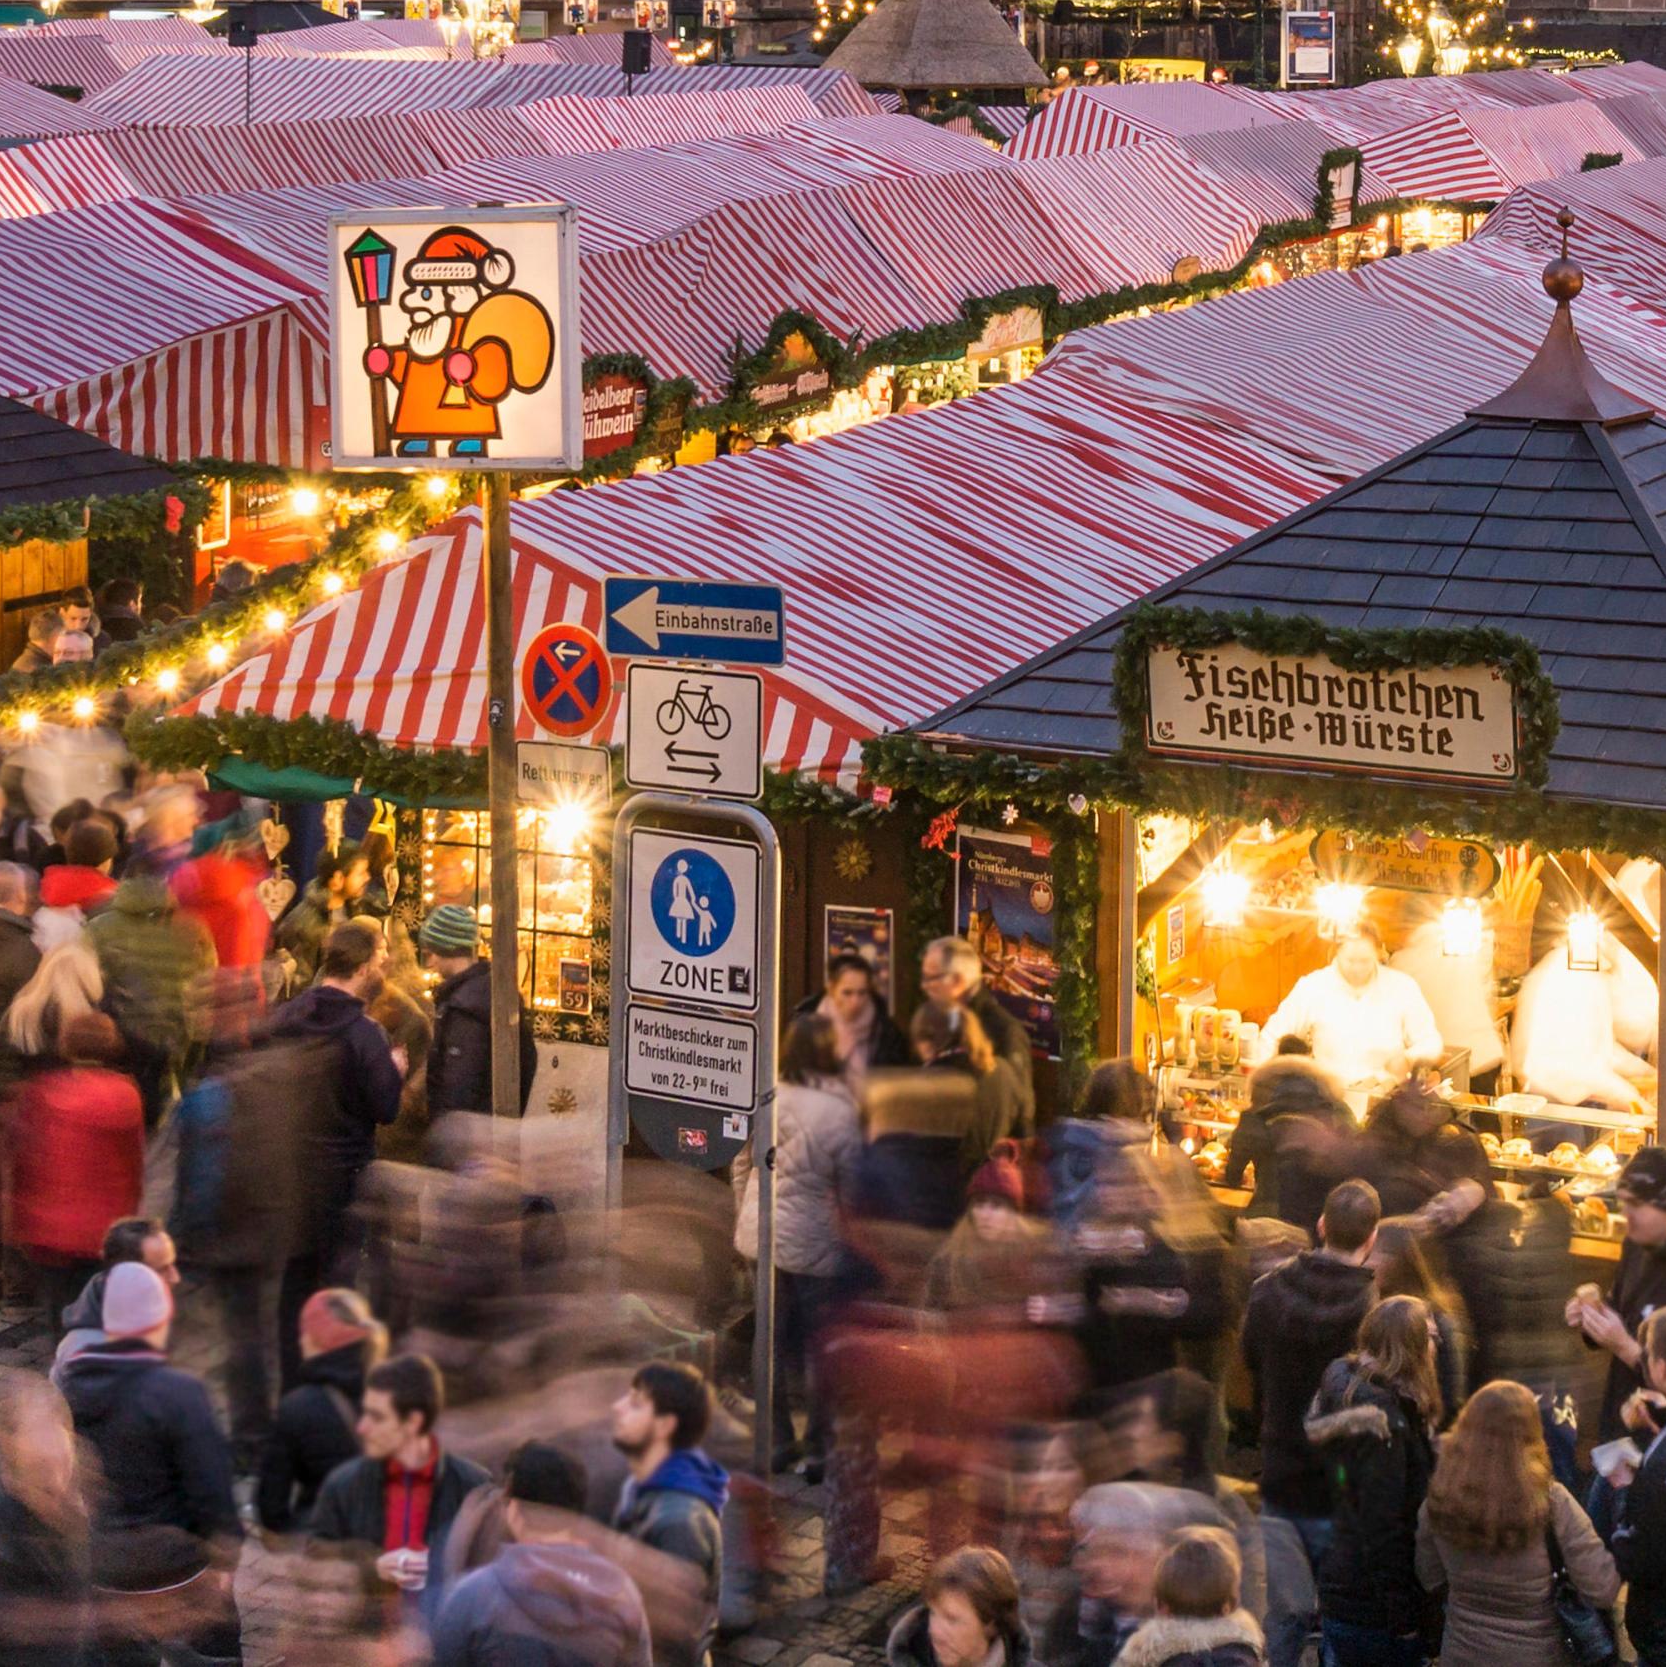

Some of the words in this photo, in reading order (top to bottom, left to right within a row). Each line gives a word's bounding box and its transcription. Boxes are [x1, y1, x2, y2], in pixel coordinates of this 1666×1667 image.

[582, 385, 634, 414] eidelbeer
[582, 407, 634, 440] ühwein
[655, 609, 773, 635] Einbahnstraße
[1314, 709, 1455, 758] Würste
[521, 761, 603, 792] Rettungseg
[968, 859, 1054, 884] Christkindlesmarkt
[660, 960, 724, 994] ZONE
[564, 991, 584, 1008] 59
[633, 1018, 724, 1049] Marktbeschicker
[727, 1037, 748, 1052] zum
[638, 1040, 742, 1074] Christkindlesmarkt
[651, 1072, 669, 1086] von
[710, 1079, 729, 1097] frei
